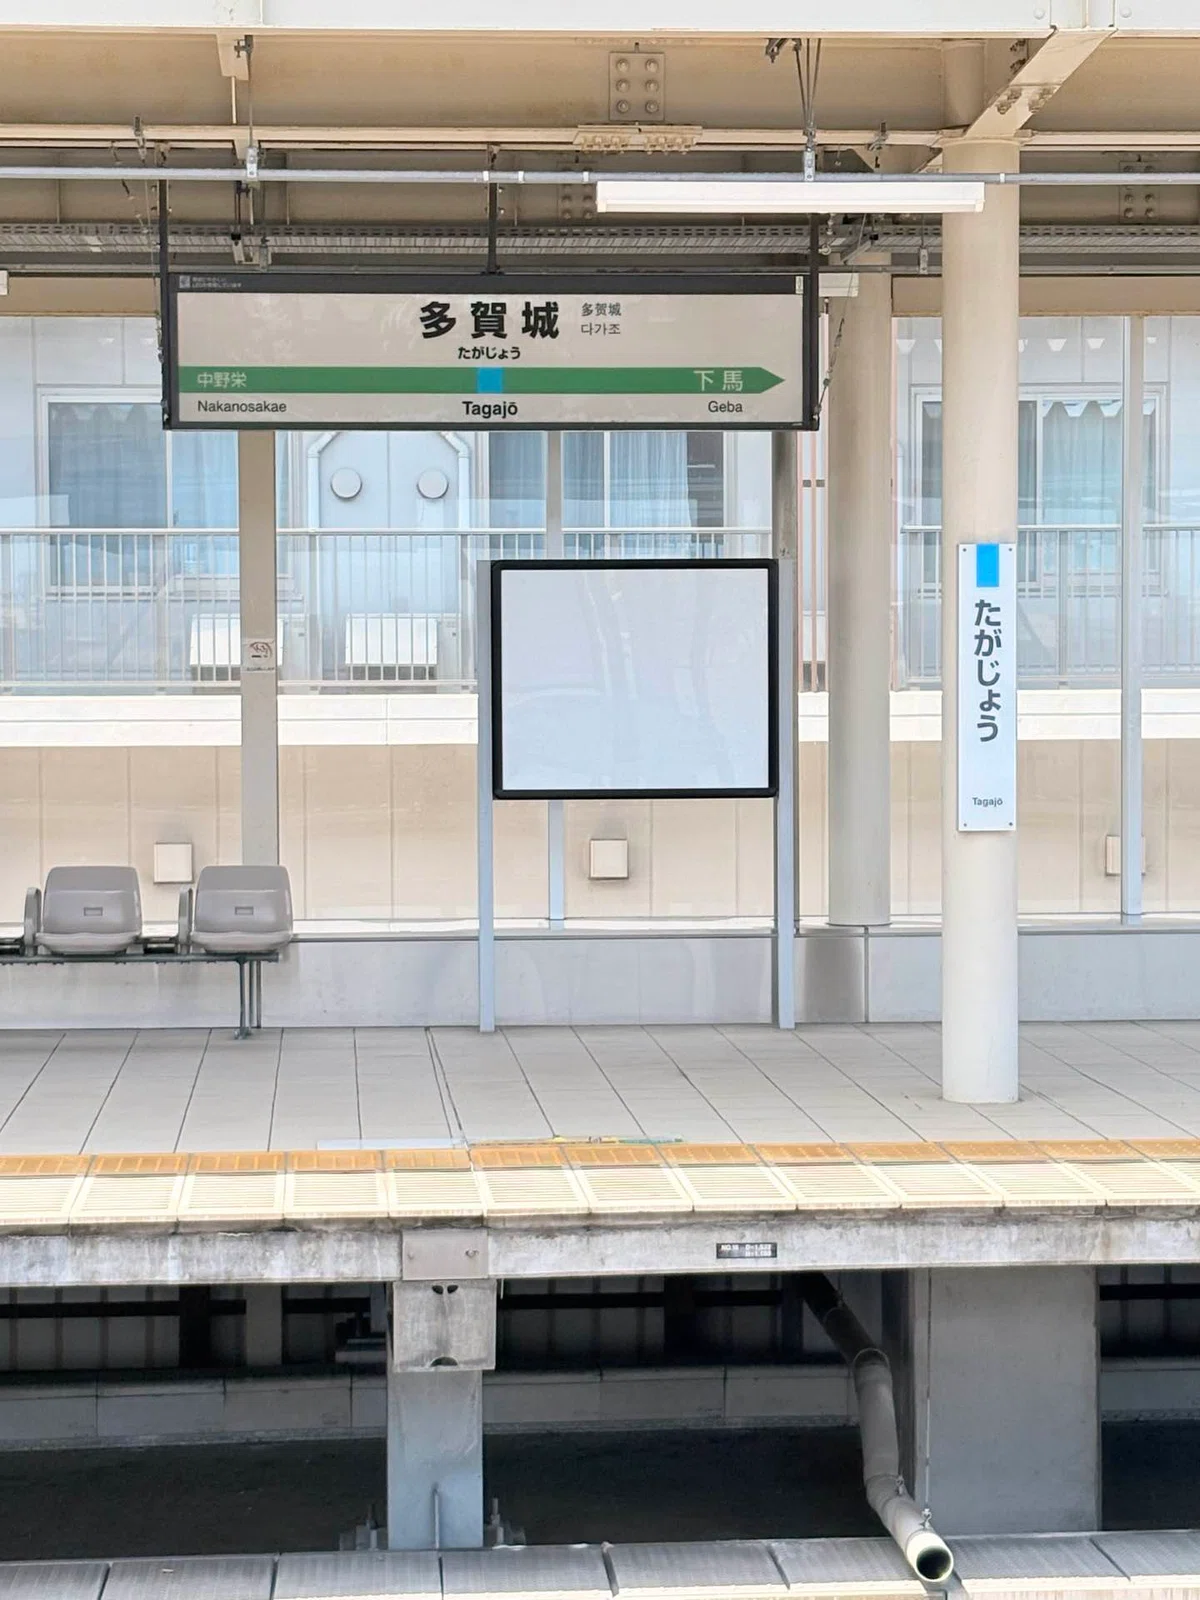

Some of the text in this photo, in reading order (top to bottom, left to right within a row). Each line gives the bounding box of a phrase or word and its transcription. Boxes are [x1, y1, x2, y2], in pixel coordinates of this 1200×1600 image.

[419, 301, 560, 340] 多賀城
[580, 322, 621, 336] 다가조
[457, 346, 522, 360] たがじょう
[197, 371, 248, 389] 中野栄
[693, 370, 744, 392] 下馬
[197, 400, 287, 413] Nakanosakae
[462, 401, 519, 419] Tagajō
[707, 400, 744, 413] Geba
[973, 599, 1003, 743] たがじょう
